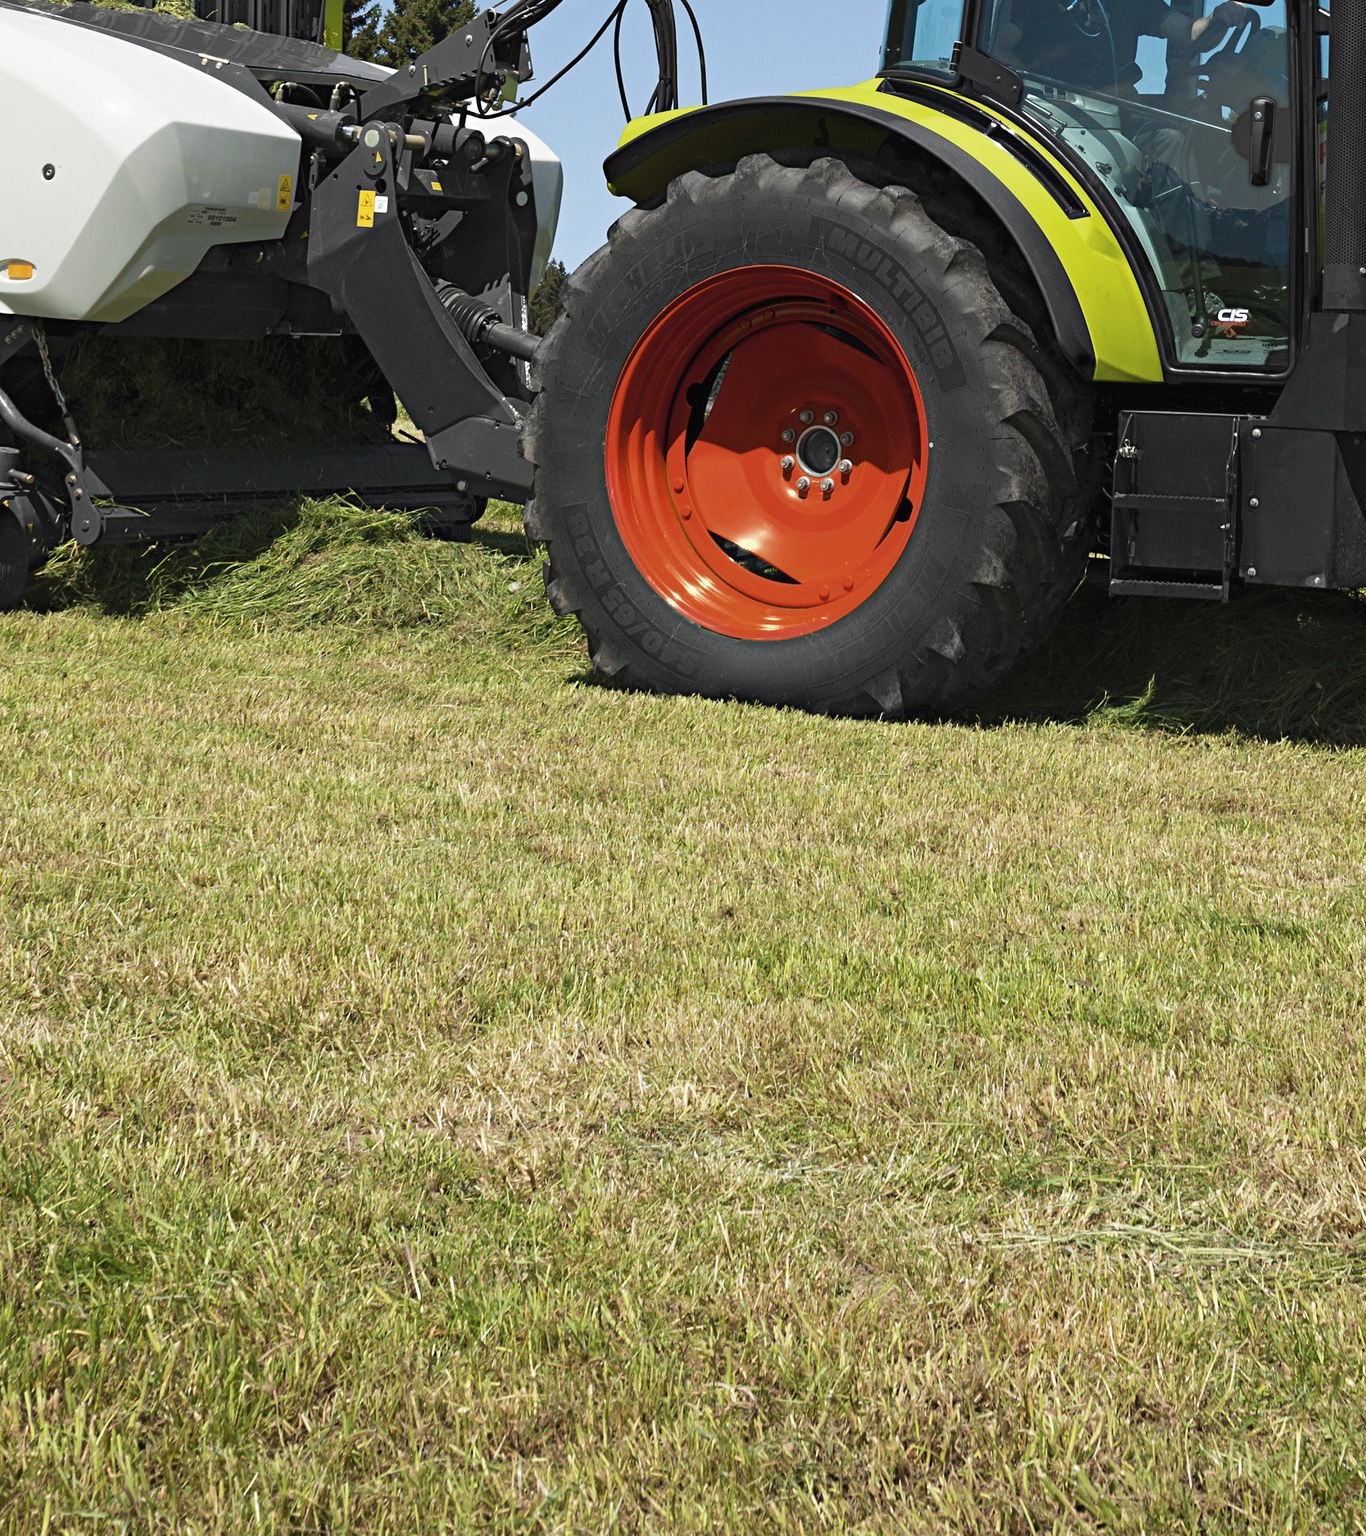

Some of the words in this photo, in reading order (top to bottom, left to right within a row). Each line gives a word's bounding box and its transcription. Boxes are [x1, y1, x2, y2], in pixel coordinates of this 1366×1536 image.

[827, 227, 954, 368] MULTIBIB
[1217, 308, 1249, 322] CIS
[568, 513, 596, 557] 38
[585, 559, 610, 589] R
[601, 589, 699, 675] 540/65
